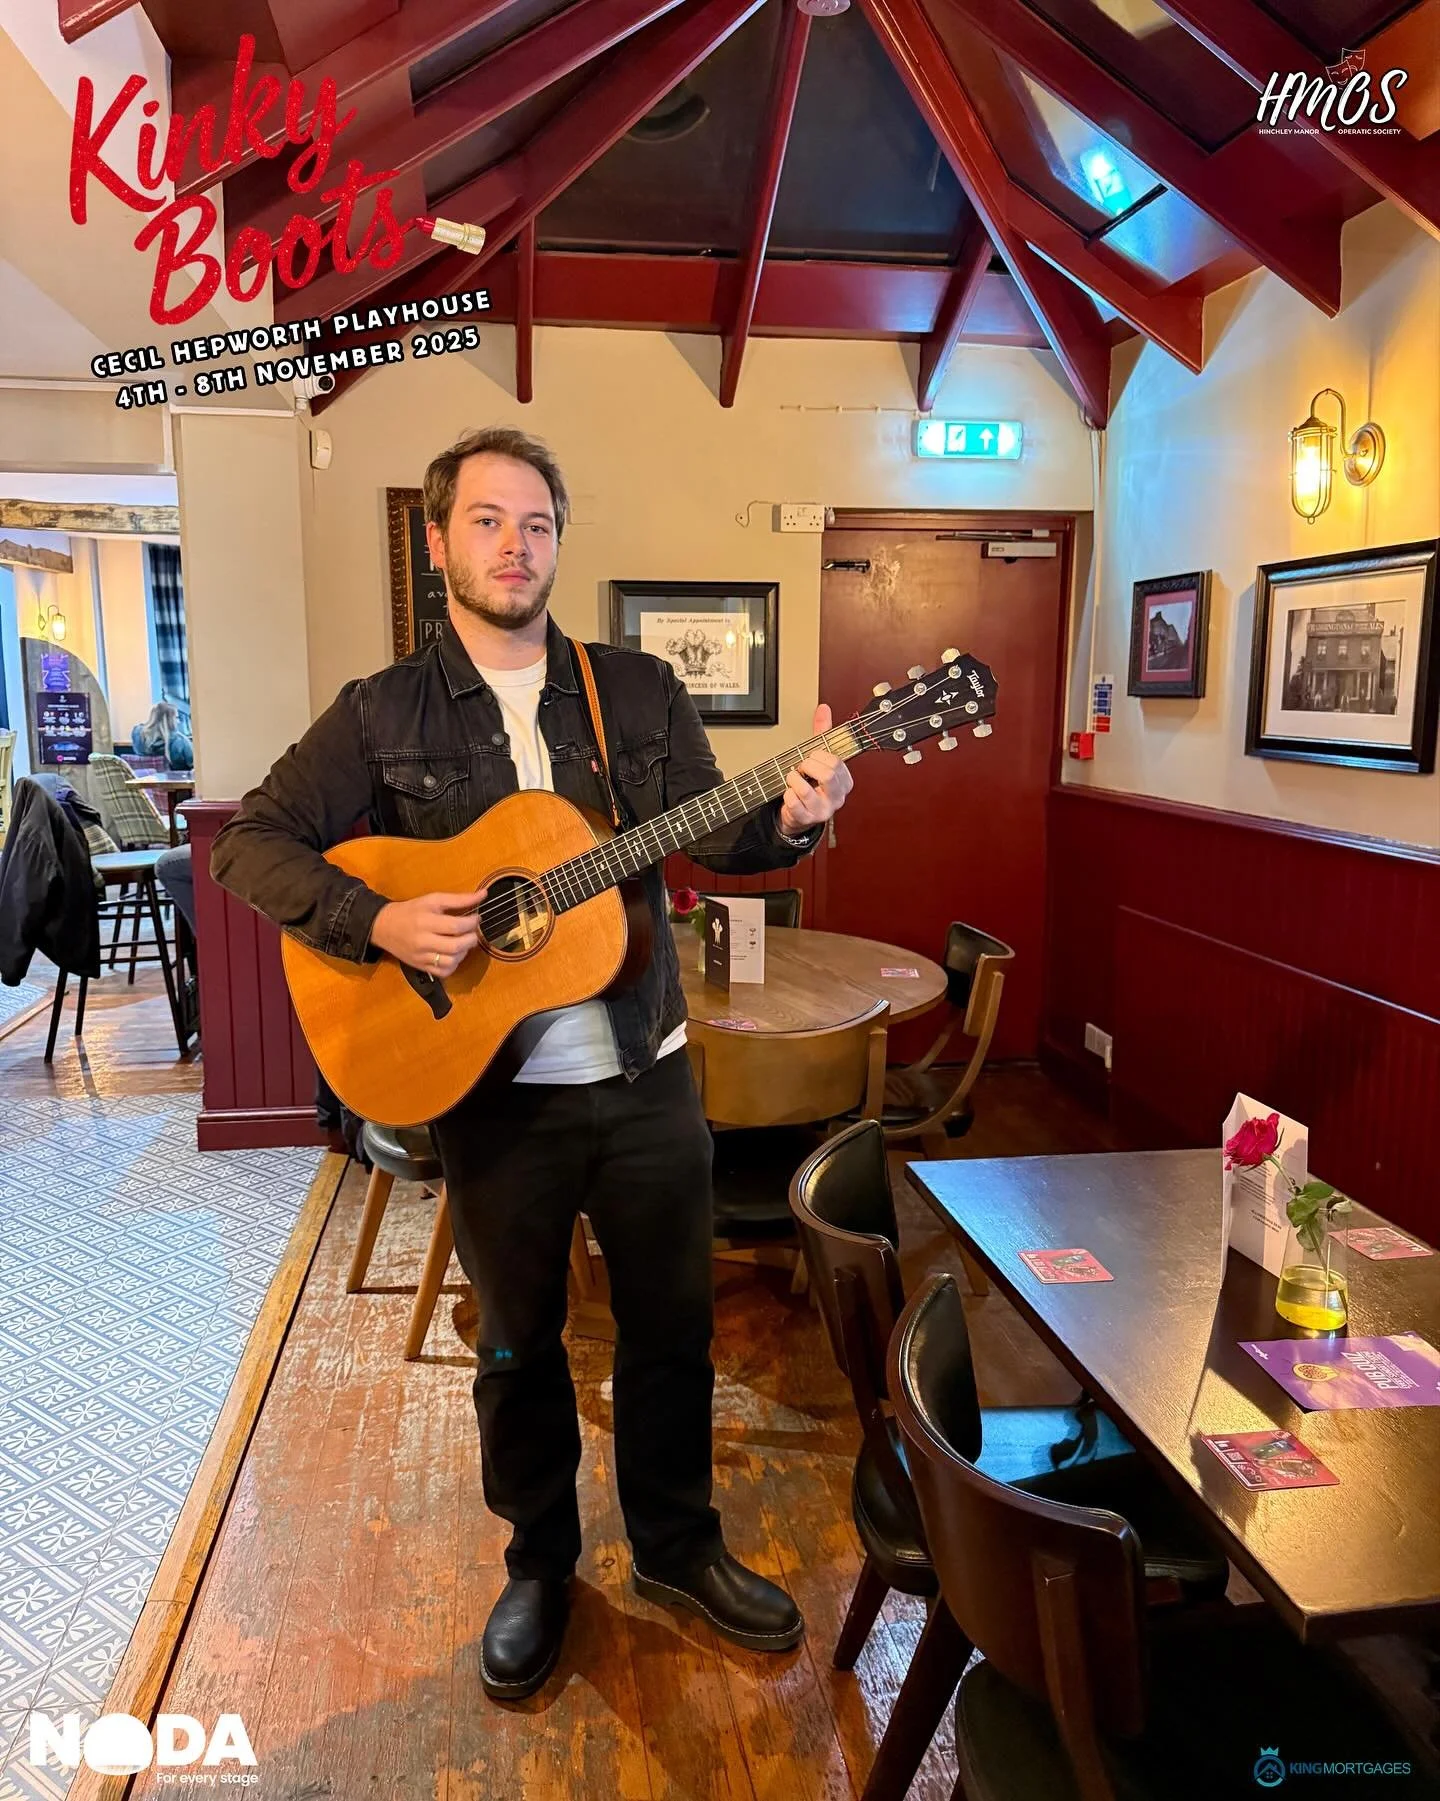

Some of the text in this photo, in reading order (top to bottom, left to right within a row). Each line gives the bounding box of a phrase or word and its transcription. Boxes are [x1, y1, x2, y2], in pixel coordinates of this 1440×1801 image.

[966, 669, 985, 698] Taylor
[1340, 1351, 1379, 1371] QUIZ
[1364, 1371, 1400, 1390] PUB
